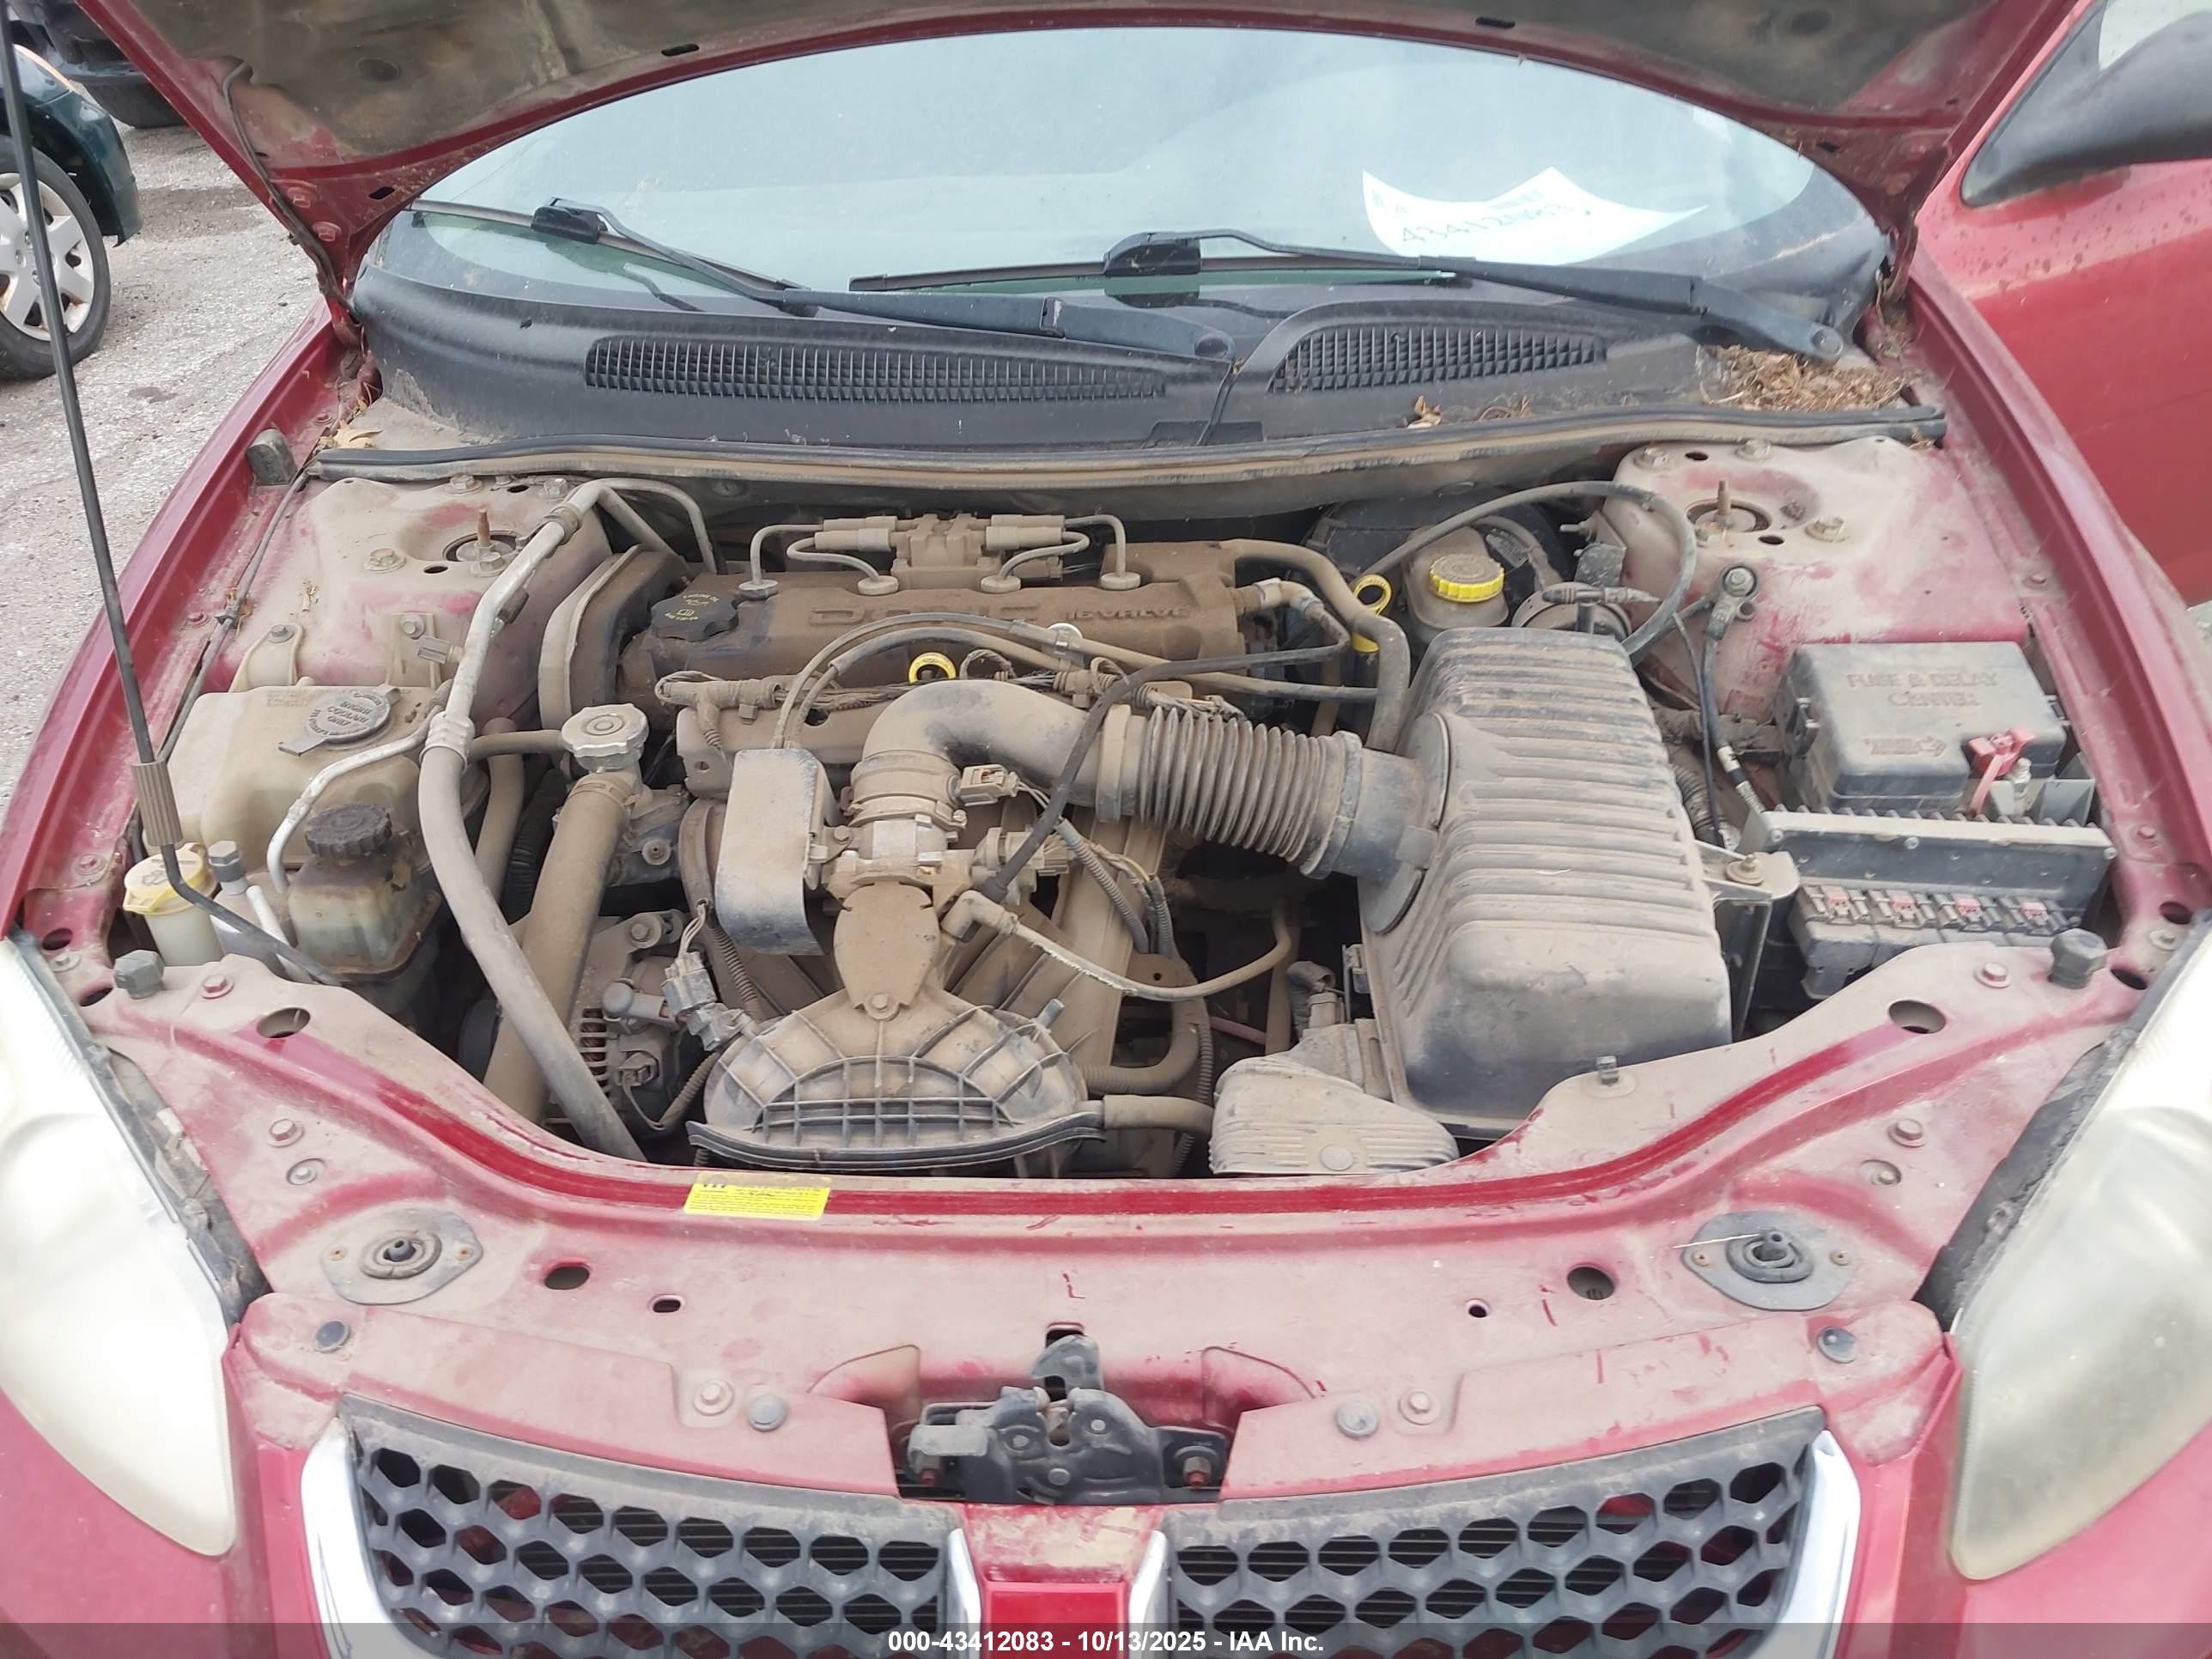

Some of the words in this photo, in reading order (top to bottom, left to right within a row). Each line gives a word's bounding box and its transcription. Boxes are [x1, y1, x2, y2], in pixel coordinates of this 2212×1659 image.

[1846, 672, 1899, 688] FUSE
[326, 715, 351, 726] ONLY
[327, 706, 370, 724] COOLANT
